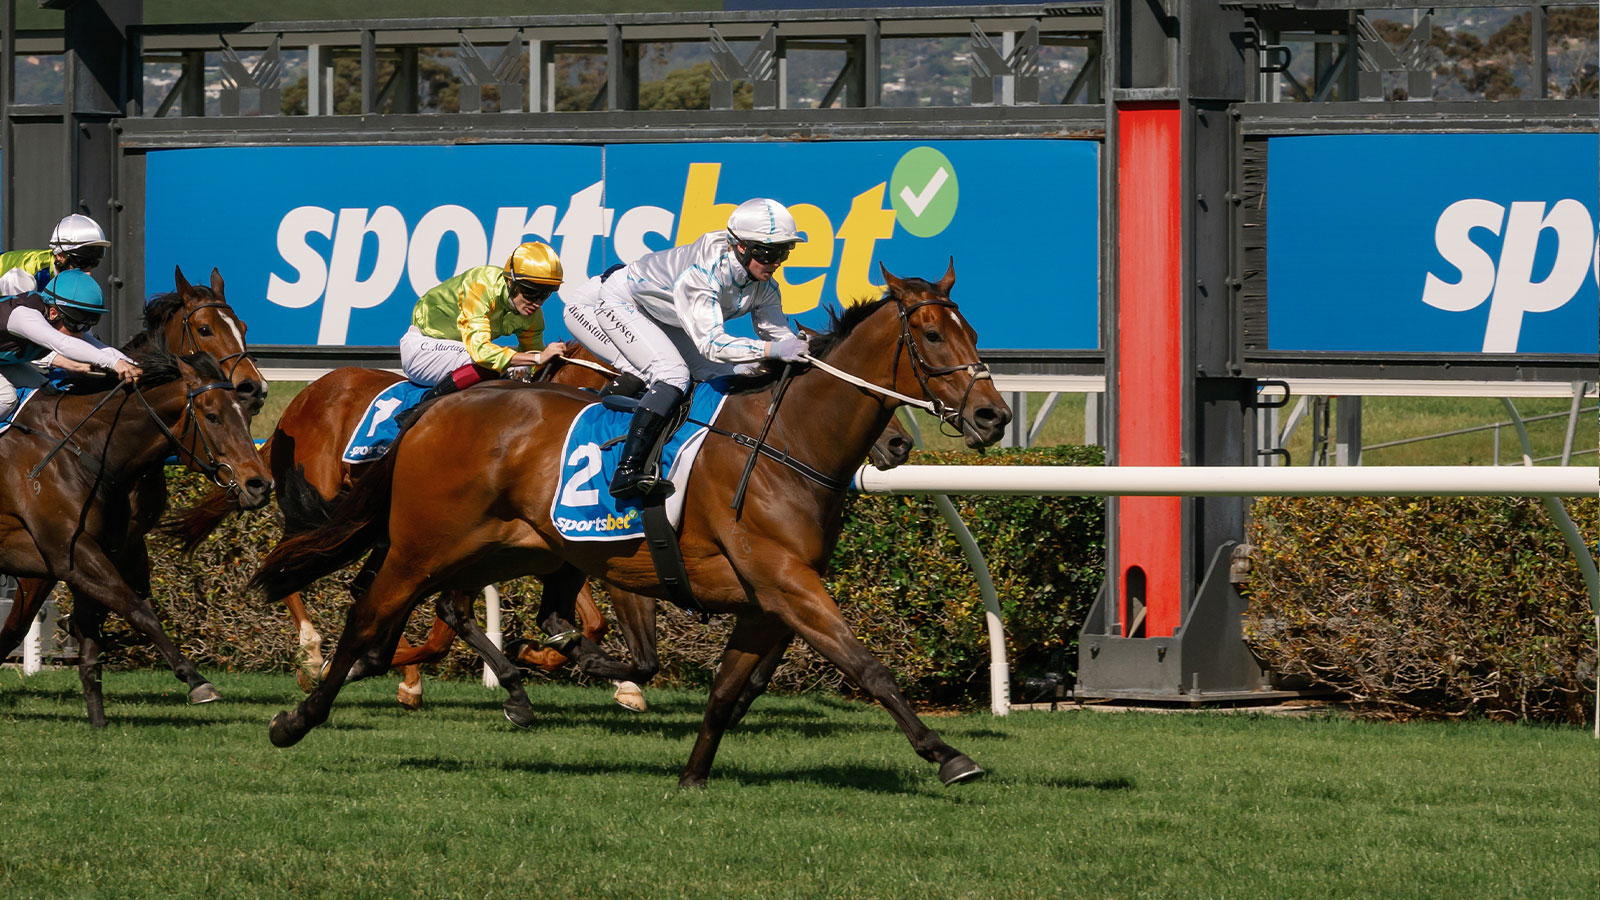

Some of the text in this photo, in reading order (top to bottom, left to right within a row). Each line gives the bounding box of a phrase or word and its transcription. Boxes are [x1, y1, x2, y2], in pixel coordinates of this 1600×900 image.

[266, 163, 897, 345] sportsbet
[1422, 199, 1599, 353] sp
[420, 341, 430, 351] C.
[366, 397, 402, 437] 1
[560, 442, 602, 507] 2
[556, 513, 631, 533] sportsbet
